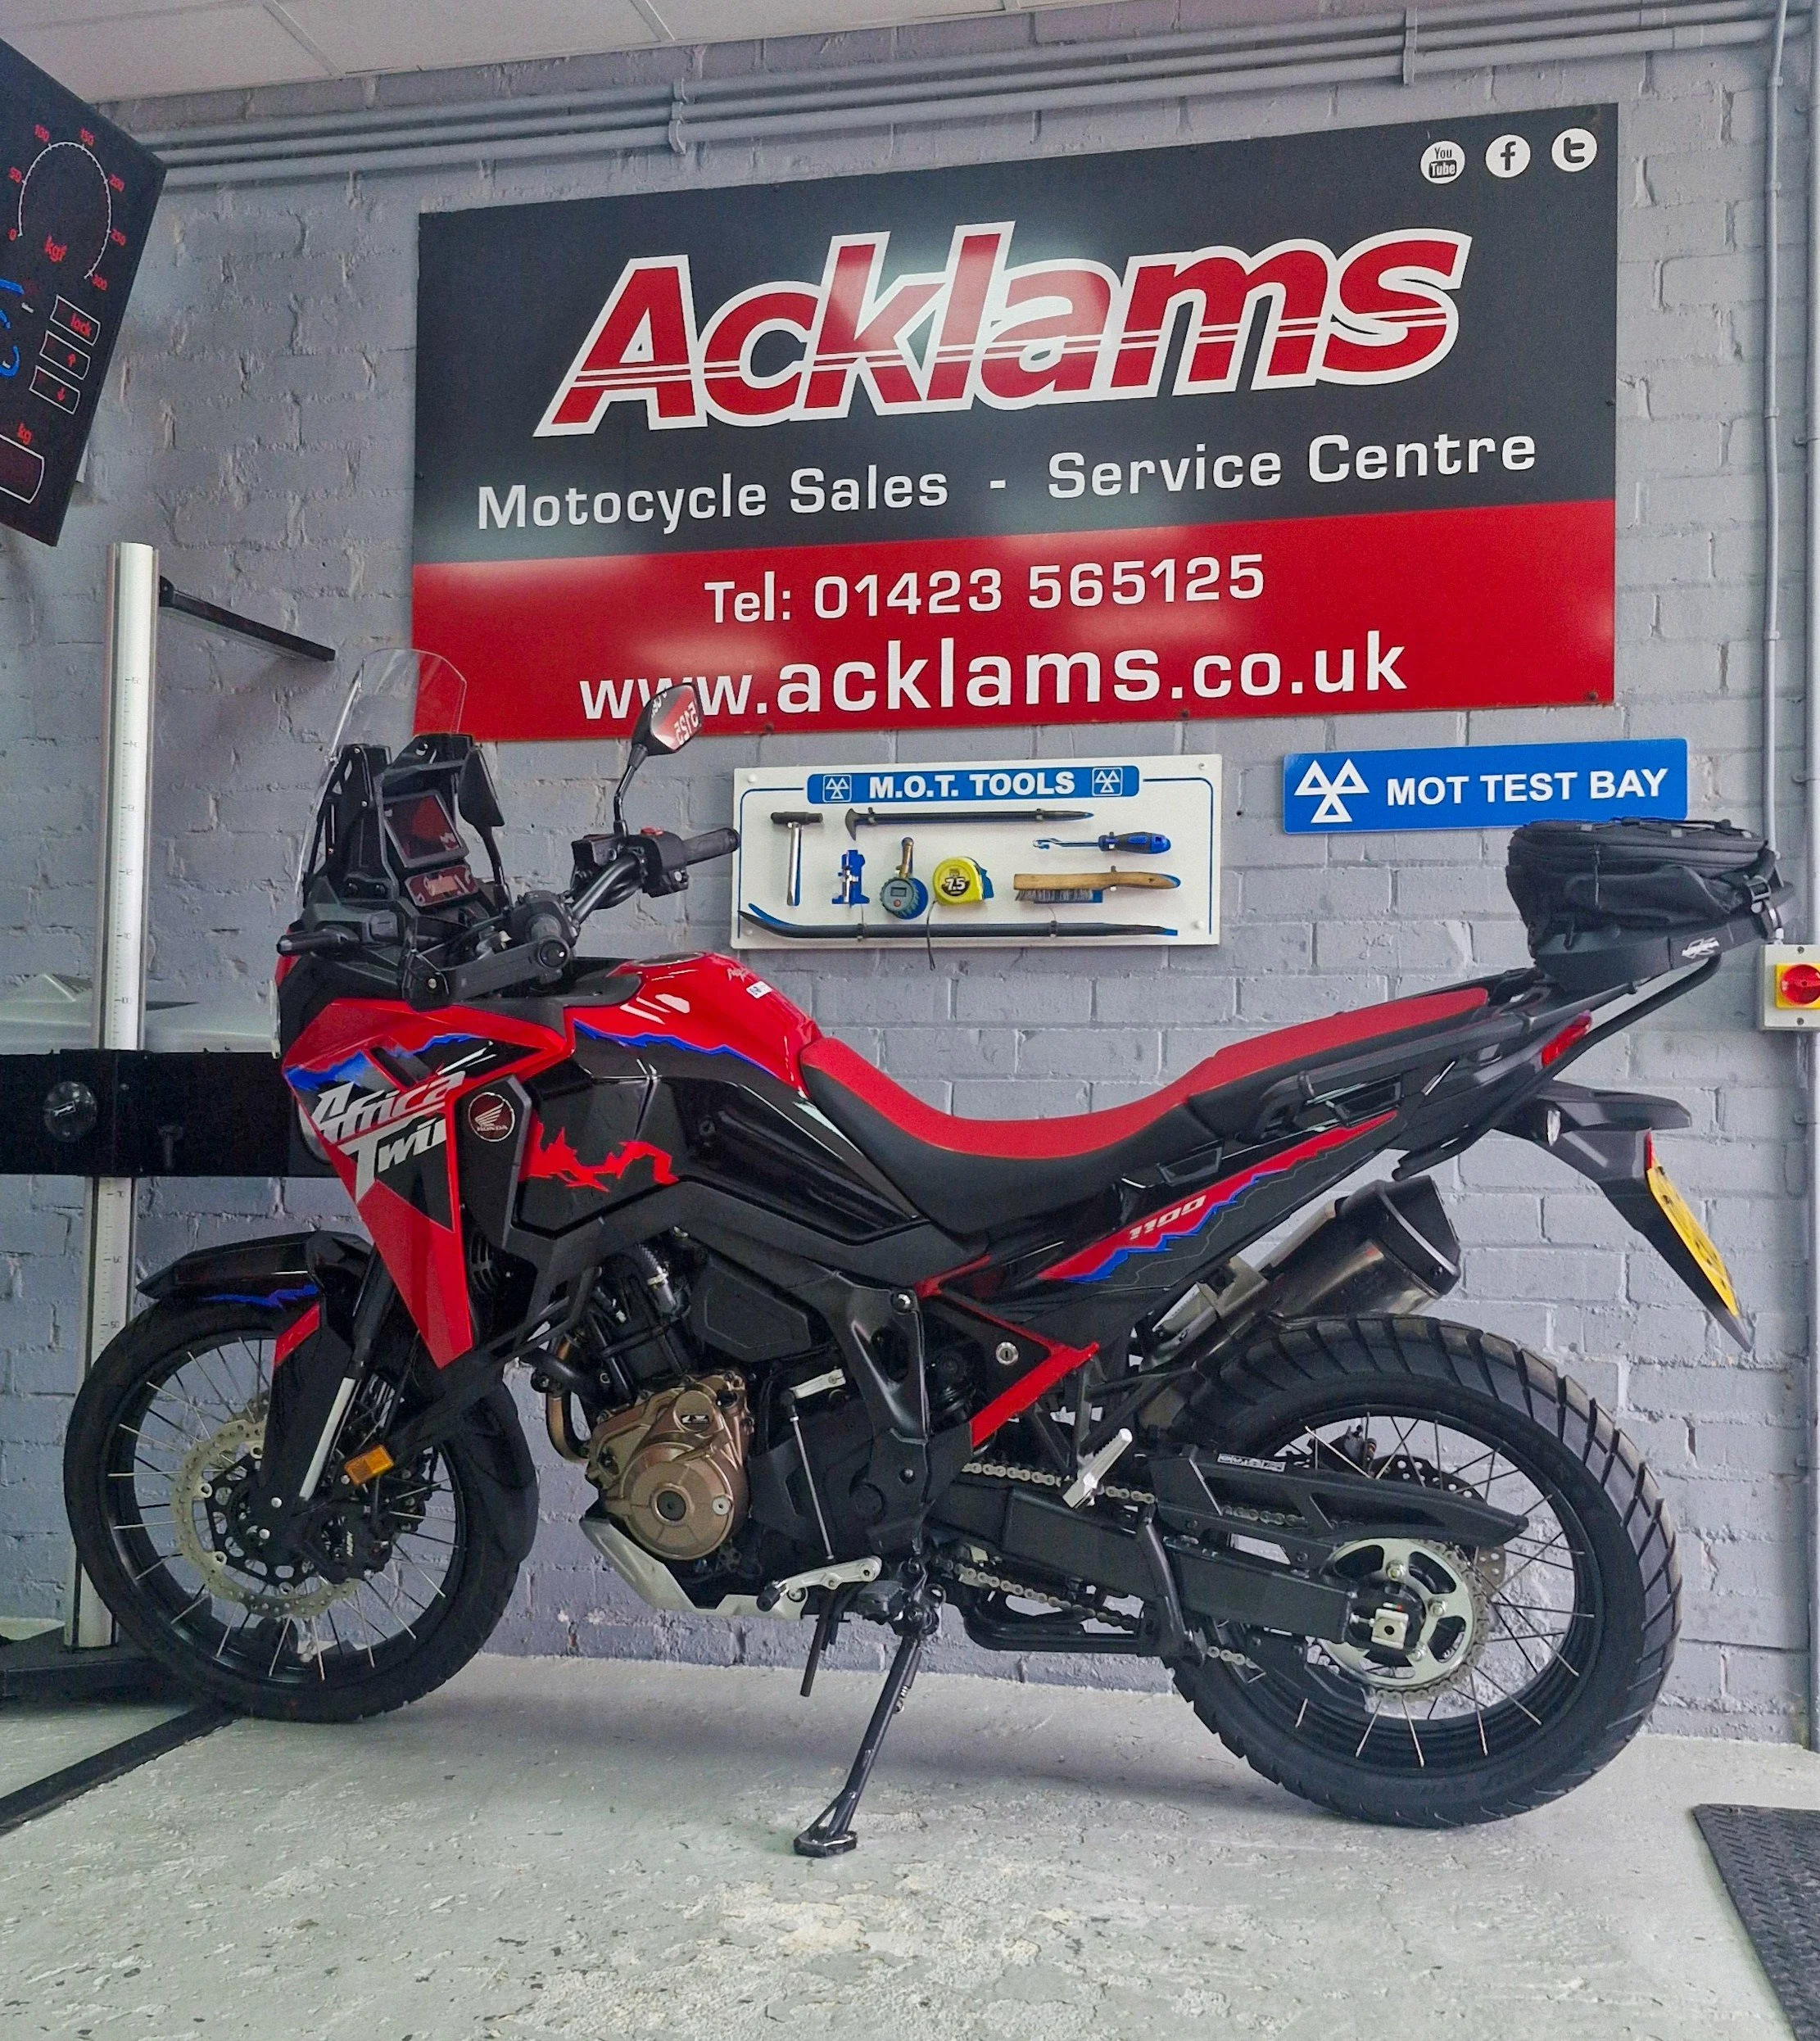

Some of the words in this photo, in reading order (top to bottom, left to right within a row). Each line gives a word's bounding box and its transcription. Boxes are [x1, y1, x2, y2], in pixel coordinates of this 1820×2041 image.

[1430, 162, 1456, 177] Tube
[1434, 147, 1452, 160] You
[70, 312, 92, 337] lock
[533, 221, 1472, 437] Acklams
[17, 422, 33, 446] kg
[478, 473, 766, 534] Motocycle
[790, 464, 948, 514] Sales
[989, 480, 1007, 490] -
[1048, 444, 1281, 499] Service
[1309, 433, 1535, 483] Centre
[704, 571, 791, 623] Tel:
[814, 568, 1002, 619] 01423
[1029, 554, 1264, 609] 565125
[869, 775, 958, 799] M.O.T.
[969, 772, 1075, 796] TOOLS
[1388, 776, 1469, 806] MOT
[1479, 772, 1578, 803] TEST
[1590, 767, 1668, 799] BAY
[944, 876, 966, 891] 7.5
[311, 1070, 465, 1144] Africa
[1130, 1195, 1207, 1241] 1100
